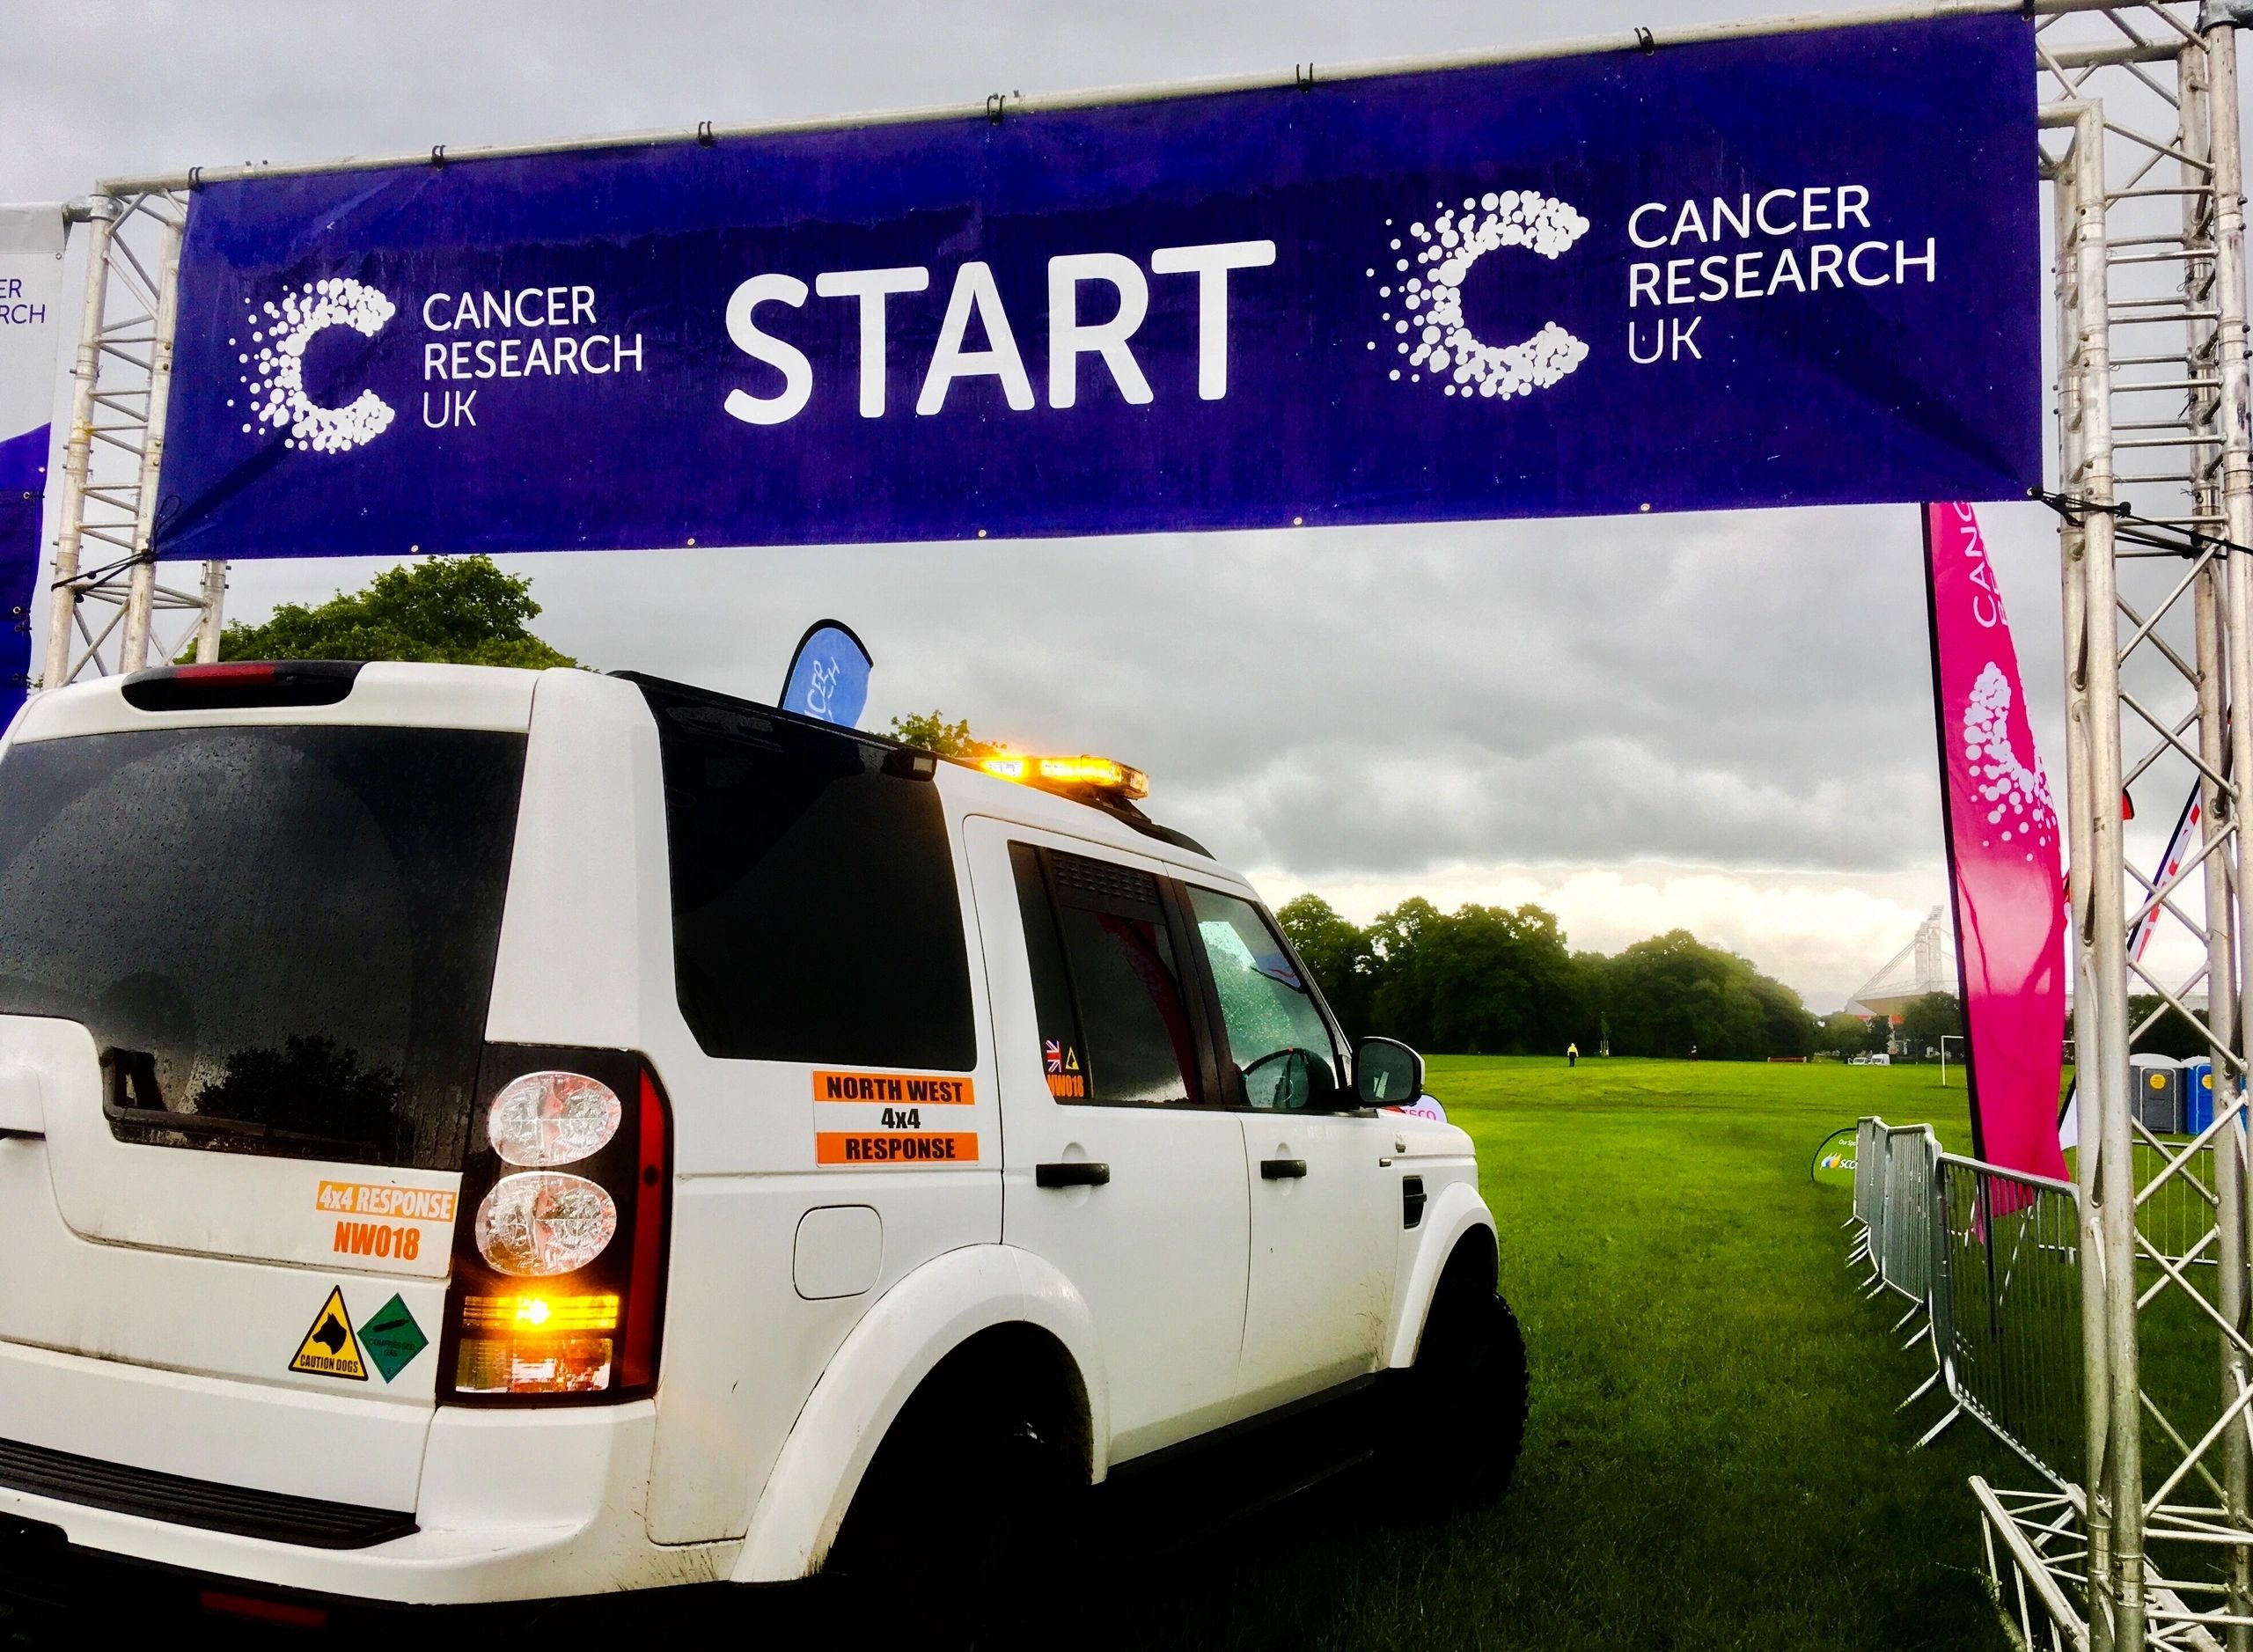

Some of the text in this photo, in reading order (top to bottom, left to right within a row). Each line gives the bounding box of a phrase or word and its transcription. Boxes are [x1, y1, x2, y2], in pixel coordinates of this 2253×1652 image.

[1629, 186, 1871, 248] CANCER
[0, 279, 22, 298] ER
[1629, 238, 1935, 308] RESEARCH
[0, 304, 46, 325] RCH
[422, 286, 597, 331] CANCER
[724, 240, 1276, 425] START
[1628, 316, 1703, 364] UK
[424, 334, 642, 380] RESEARCH
[422, 390, 477, 429] UK
[1953, 502, 1997, 628] CANC
[826, 1076, 964, 1103] NORTH WEST
[881, 1107, 921, 1129] 4x4
[845, 1137, 956, 1161] RESPONSE
[319, 1185, 454, 1220] 4x4 RESPONSE
[334, 1221, 422, 1260] NW018
[300, 1354, 358, 1374] CAUTION DOGS
